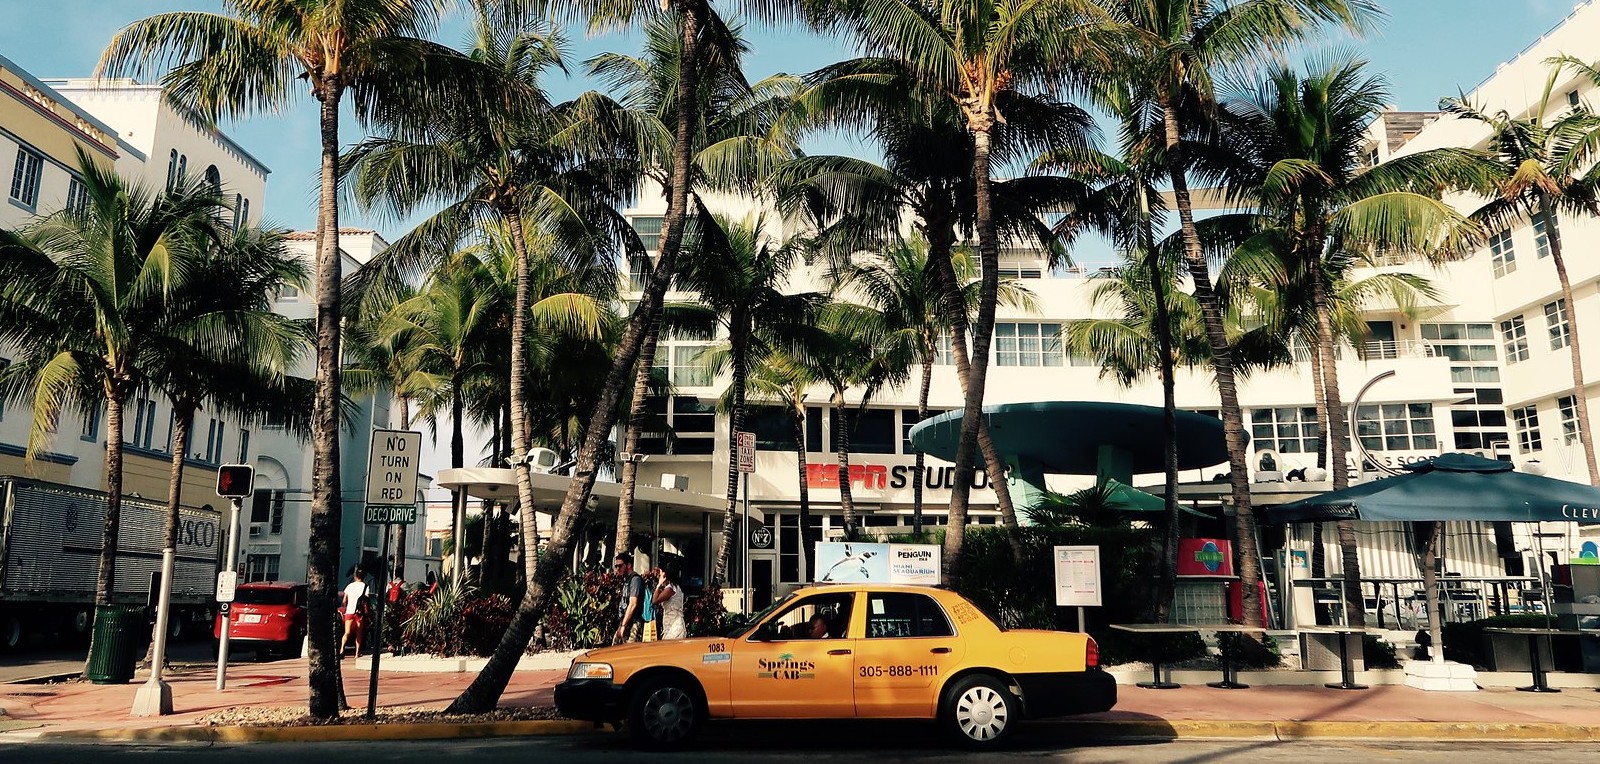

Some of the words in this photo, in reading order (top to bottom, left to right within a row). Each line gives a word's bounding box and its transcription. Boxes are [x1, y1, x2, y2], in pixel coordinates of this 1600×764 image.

[387, 437, 405, 451] NO
[381, 456, 409, 467] TURN
[740, 455, 753, 463] ZONE
[386, 472, 402, 483] ON
[805, 464, 887, 489] ESPN
[891, 465, 994, 489] STUDO
[382, 488, 403, 500] RED
[367, 508, 388, 521] DECO
[390, 509, 414, 521] DRIVE
[1563, 505, 1598, 518] CLEV
[177, 520, 214, 547] YSCO
[708, 643, 725, 653] 1083
[758, 658, 815, 673] Springs
[859, 665, 938, 677] 305-888-1111
[773, 670, 800, 680] CAB
